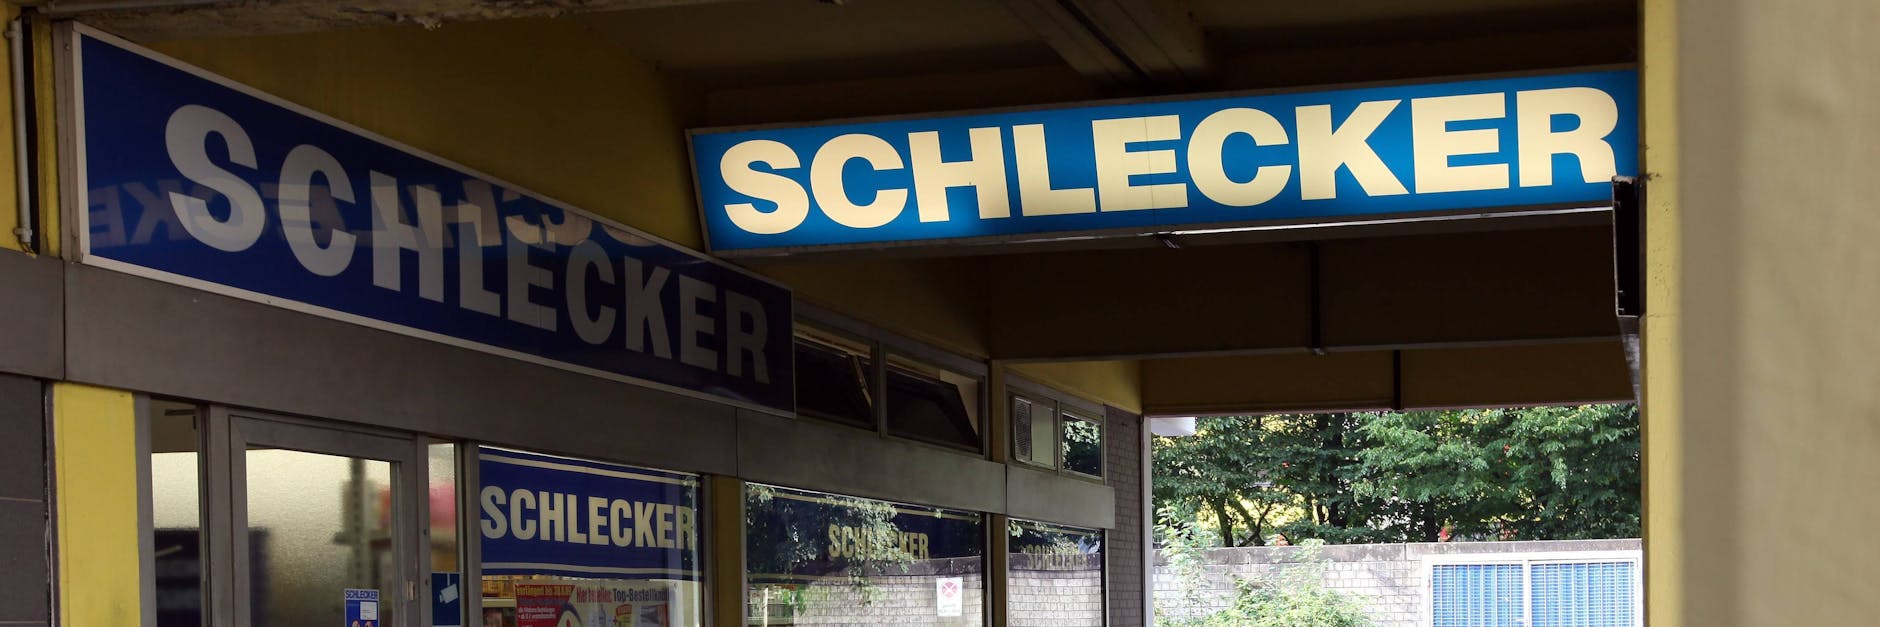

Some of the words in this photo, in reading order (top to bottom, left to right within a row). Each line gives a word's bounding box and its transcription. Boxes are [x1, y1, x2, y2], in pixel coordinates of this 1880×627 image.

[718, 86, 1619, 235] SCHLECKER
[165, 104, 771, 384] SCHLECKER
[480, 485, 694, 550] SCHLECKER
[828, 523, 929, 560] SCHLCKER
[346, 590, 378, 599] SCHLECKER
